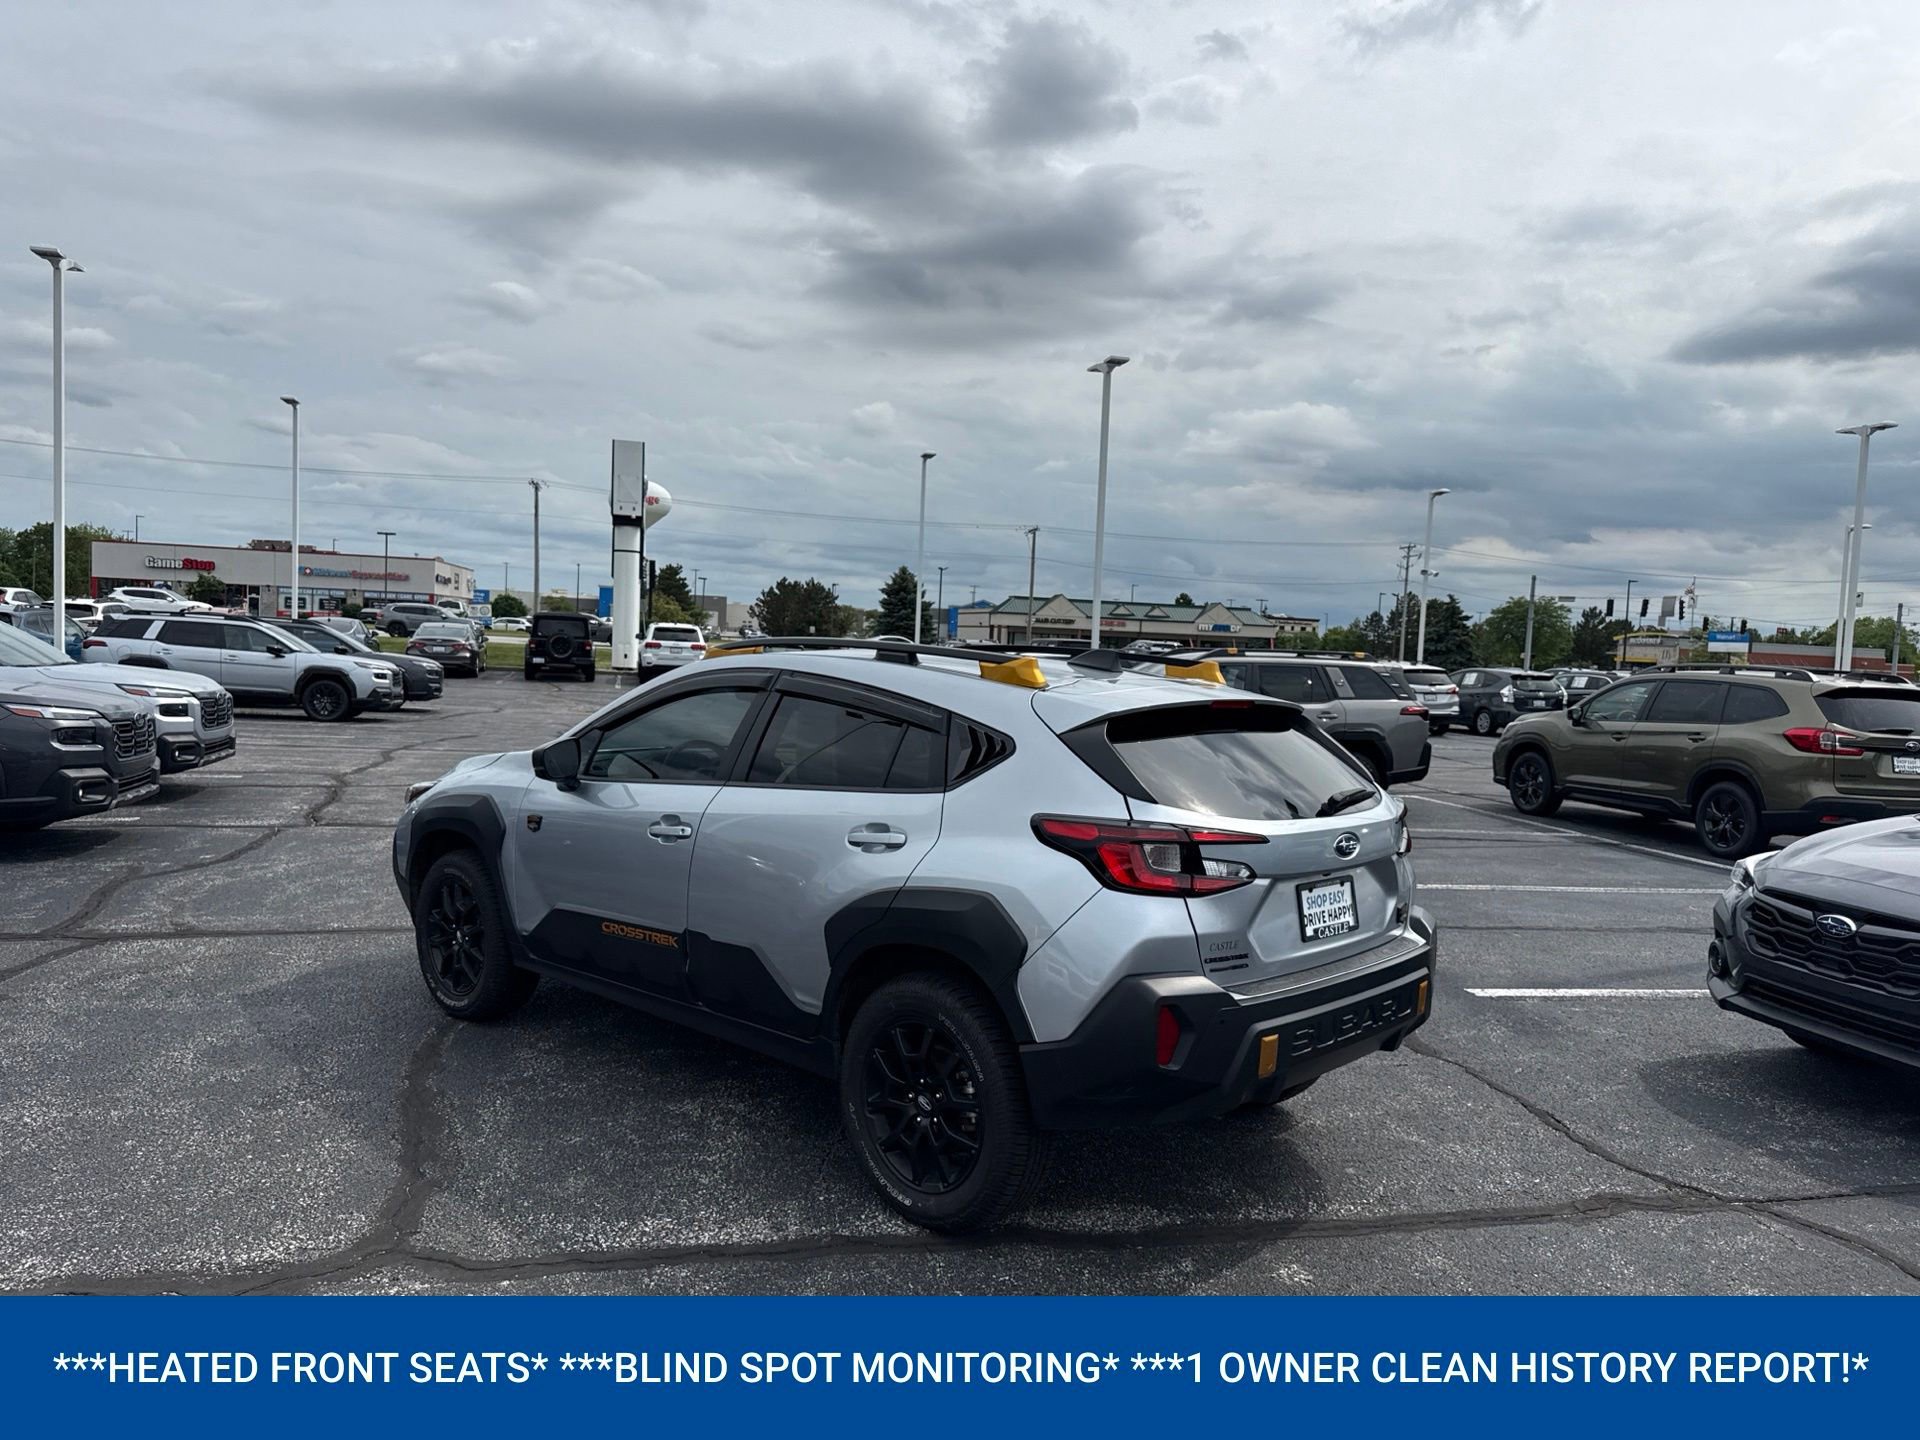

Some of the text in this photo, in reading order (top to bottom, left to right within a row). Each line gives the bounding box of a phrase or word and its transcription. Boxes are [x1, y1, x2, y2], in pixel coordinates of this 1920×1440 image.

[145, 556, 215, 570] GameStop
[1306, 889, 1348, 910] SHOP EASY,
[1304, 904, 1355, 928] DRIVE HAPPY!
[601, 921, 679, 948] CROSSTREK
[1318, 922, 1349, 938] CASTLE
[1210, 940, 1238, 952] CASTLE
[1290, 996, 1413, 1057] SUBARU
